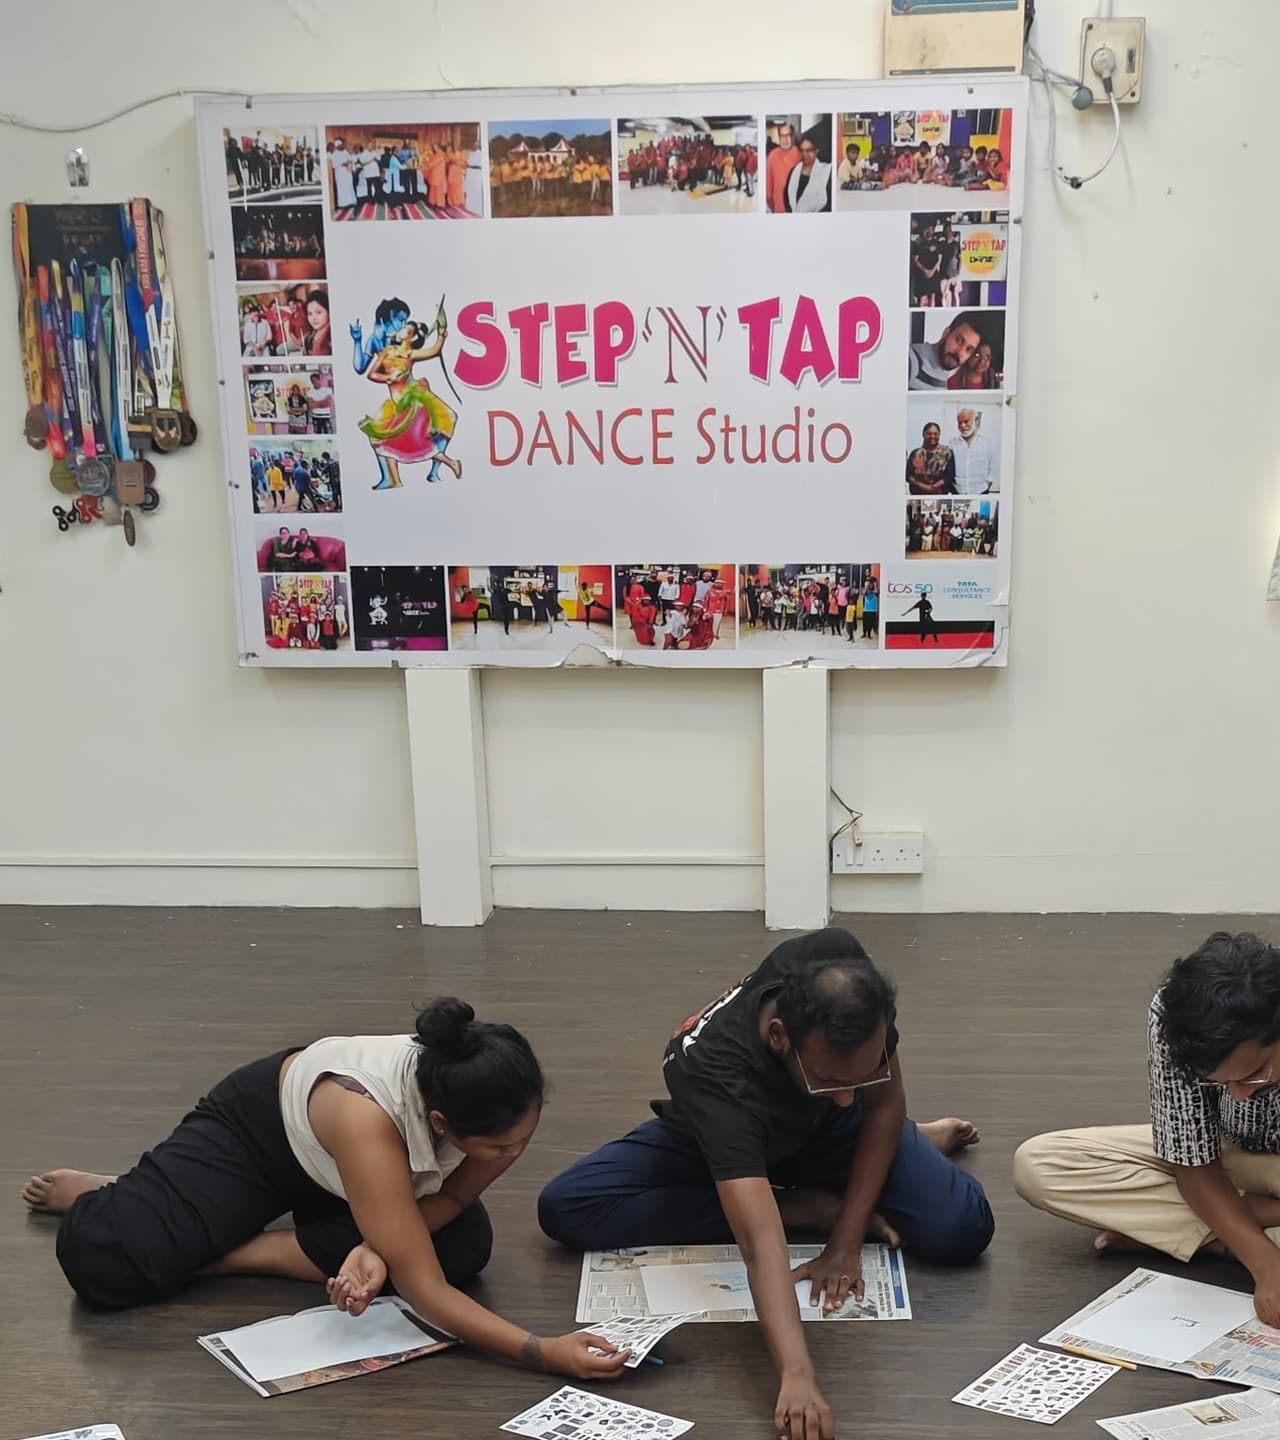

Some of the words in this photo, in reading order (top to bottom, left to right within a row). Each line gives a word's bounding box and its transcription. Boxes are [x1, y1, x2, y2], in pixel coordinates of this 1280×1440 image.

[455, 299, 636, 391] STEP
[737, 293, 886, 388] TAP
[489, 410, 675, 468] DANCE
[697, 406, 854, 466] Studio
[888, 582, 912, 593] tcs
